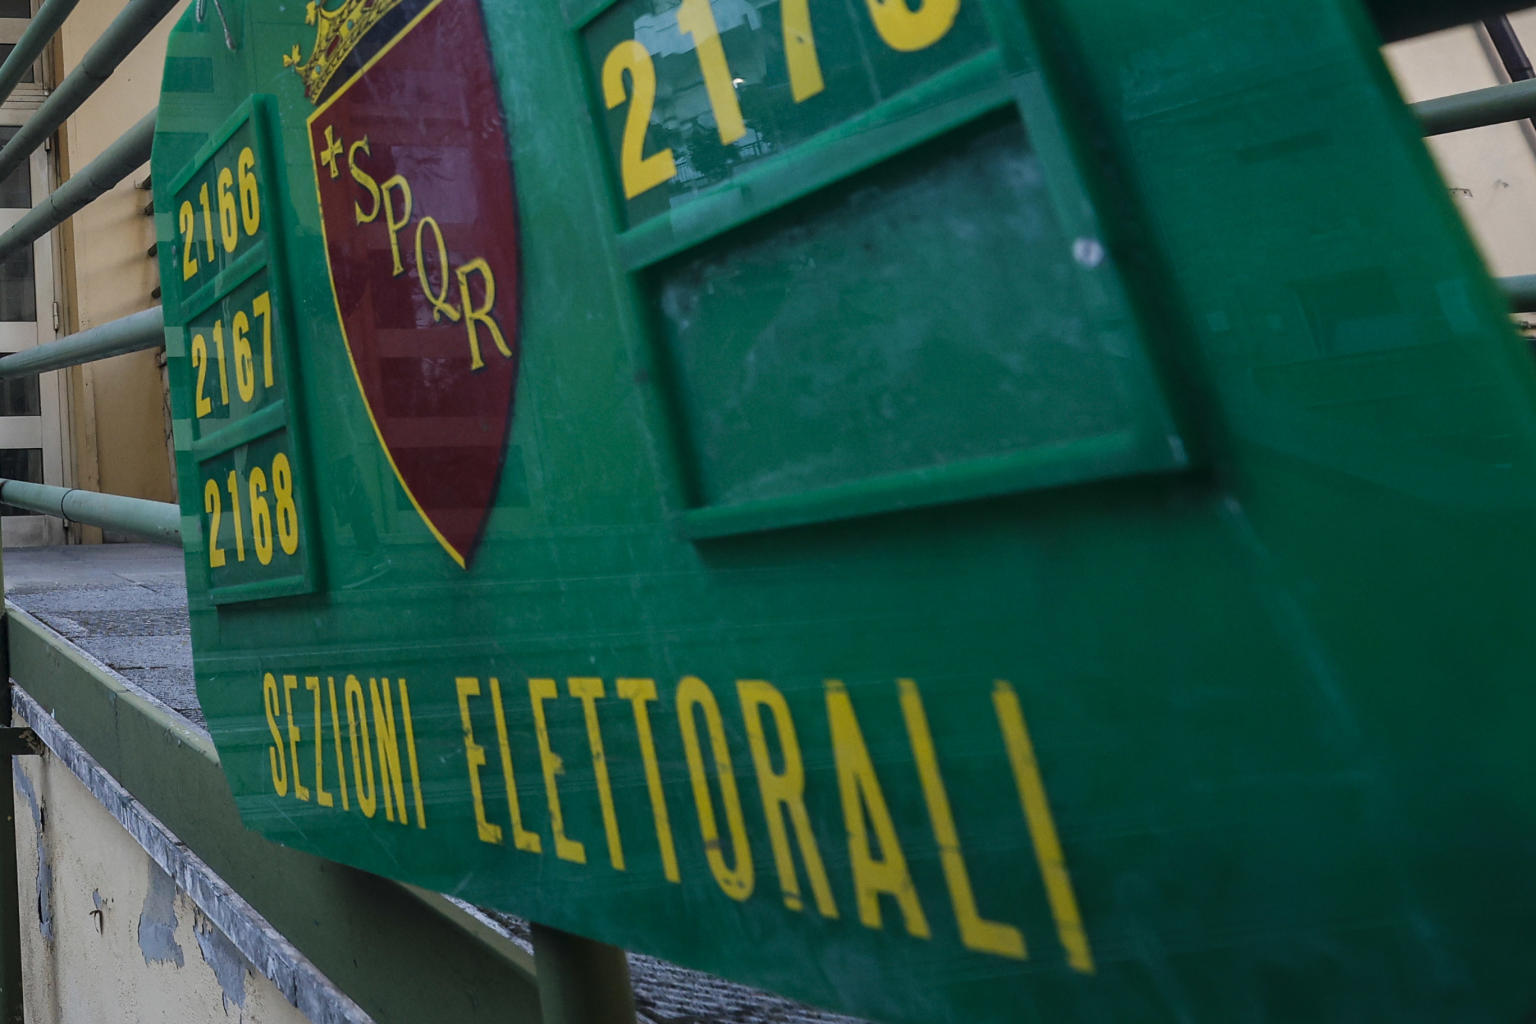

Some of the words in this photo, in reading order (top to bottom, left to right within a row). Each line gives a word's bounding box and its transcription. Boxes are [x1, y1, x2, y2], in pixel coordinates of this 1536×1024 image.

[179, 146, 262, 282] 2166
[347, 133, 512, 373] SPQR
[191, 290, 276, 419] 2167
[204, 452, 299, 568] 2168
[263, 671, 426, 829] SEZIONI
[455, 675, 1096, 973] ELETTORALI
